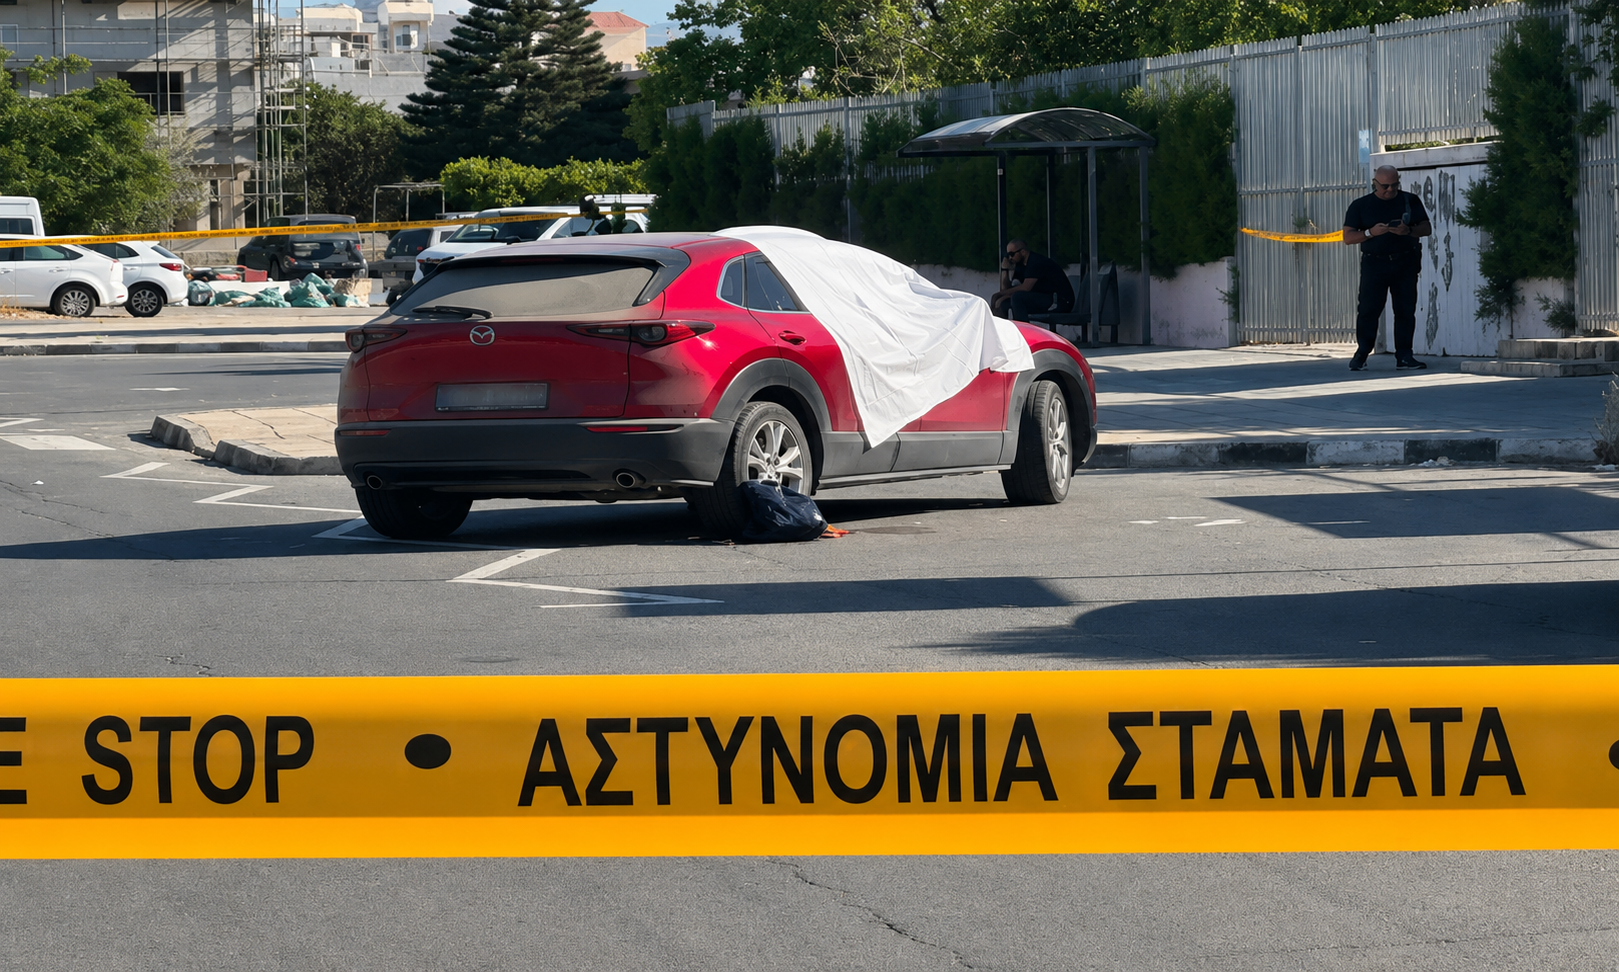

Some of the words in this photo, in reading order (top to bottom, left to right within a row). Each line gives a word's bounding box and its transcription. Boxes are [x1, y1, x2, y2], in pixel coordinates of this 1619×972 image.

[82, 715, 314, 805] STOP
[518, 713, 1058, 807] ΑΣΤΥΝΟΜΙΑ
[1108, 706, 1526, 801] ΣΤΑΜΑΤΑ
